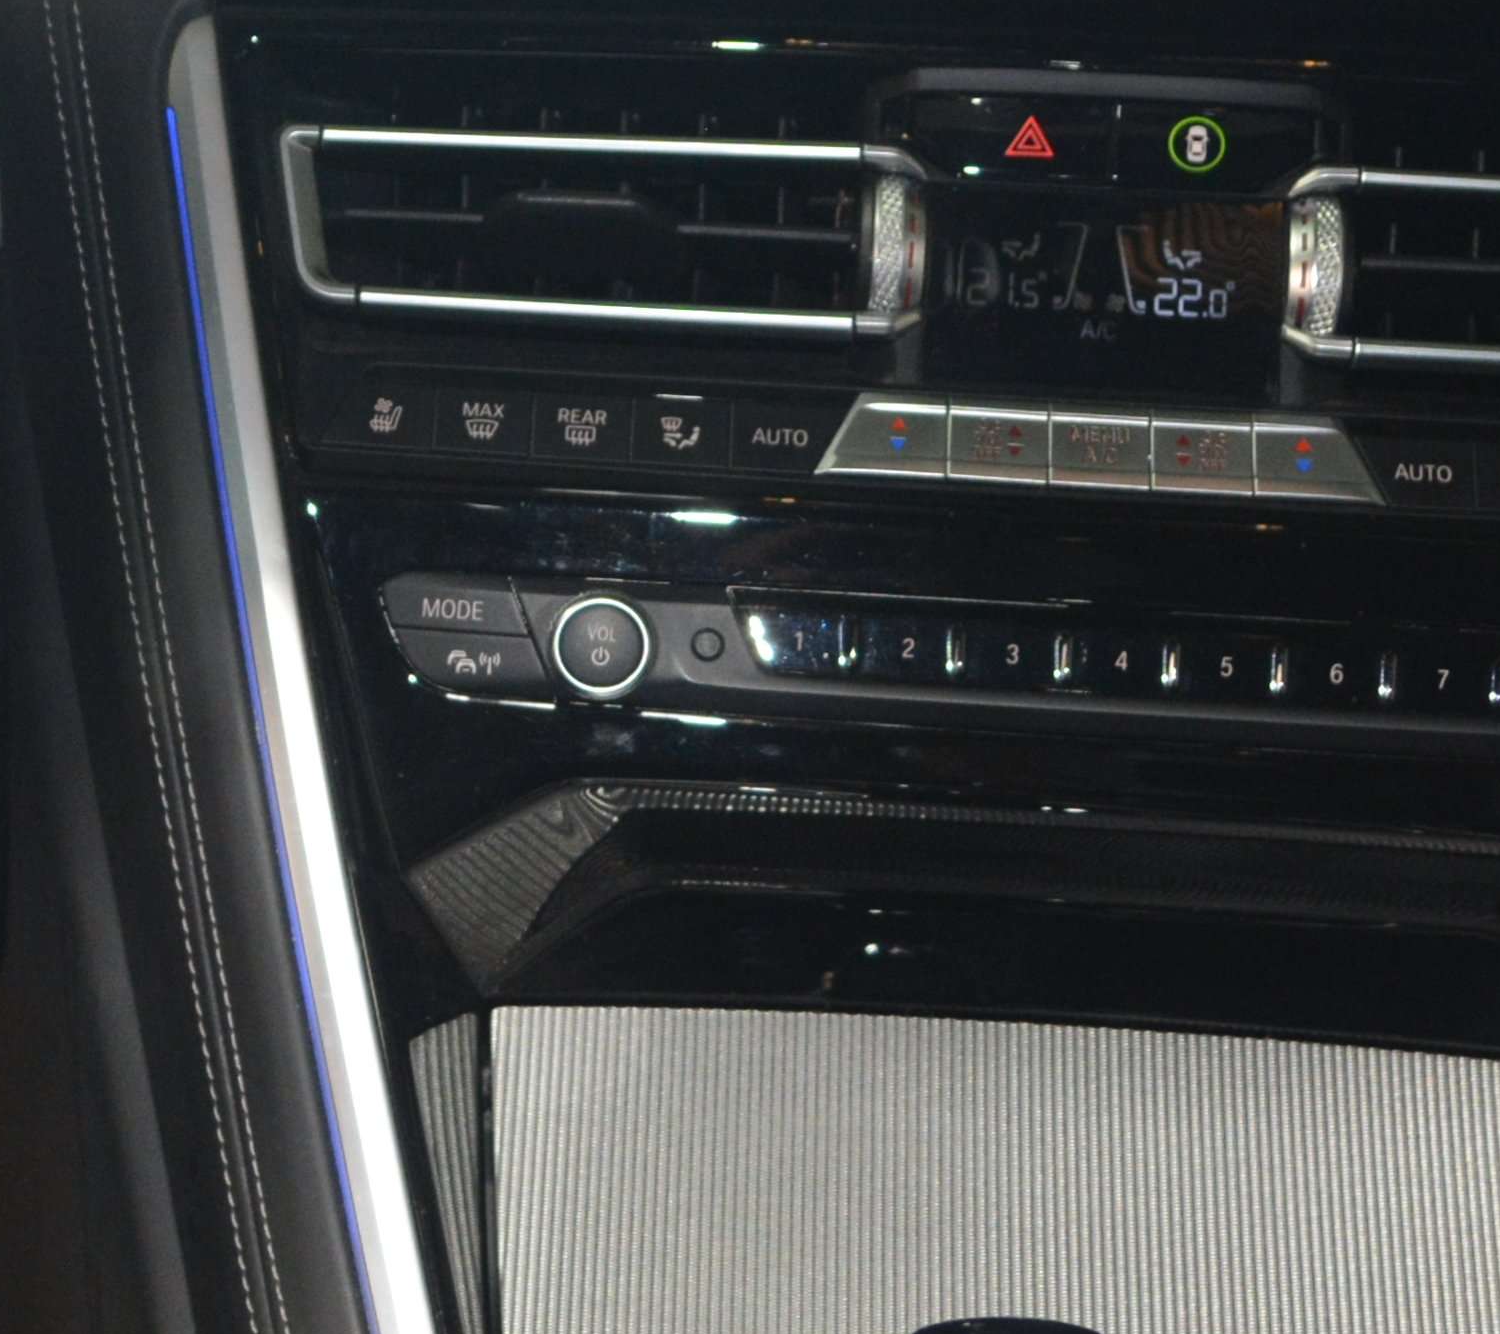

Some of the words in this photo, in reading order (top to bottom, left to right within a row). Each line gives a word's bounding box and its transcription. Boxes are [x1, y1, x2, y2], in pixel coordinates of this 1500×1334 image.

[462, 402, 504, 419] MAX
[557, 408, 607, 426] REAR
[751, 427, 809, 447] AUTO
[1394, 464, 1453, 484] AUTO
[421, 599, 484, 622] MODE
[587, 625, 617, 643] VOL
[902, 638, 915, 658] 2
[1006, 644, 1020, 665] 3
[1114, 650, 1129, 670] 4
[1220, 656, 1233, 678] 5
[1329, 662, 1344, 684] 6
[1437, 669, 1449, 690] 7
